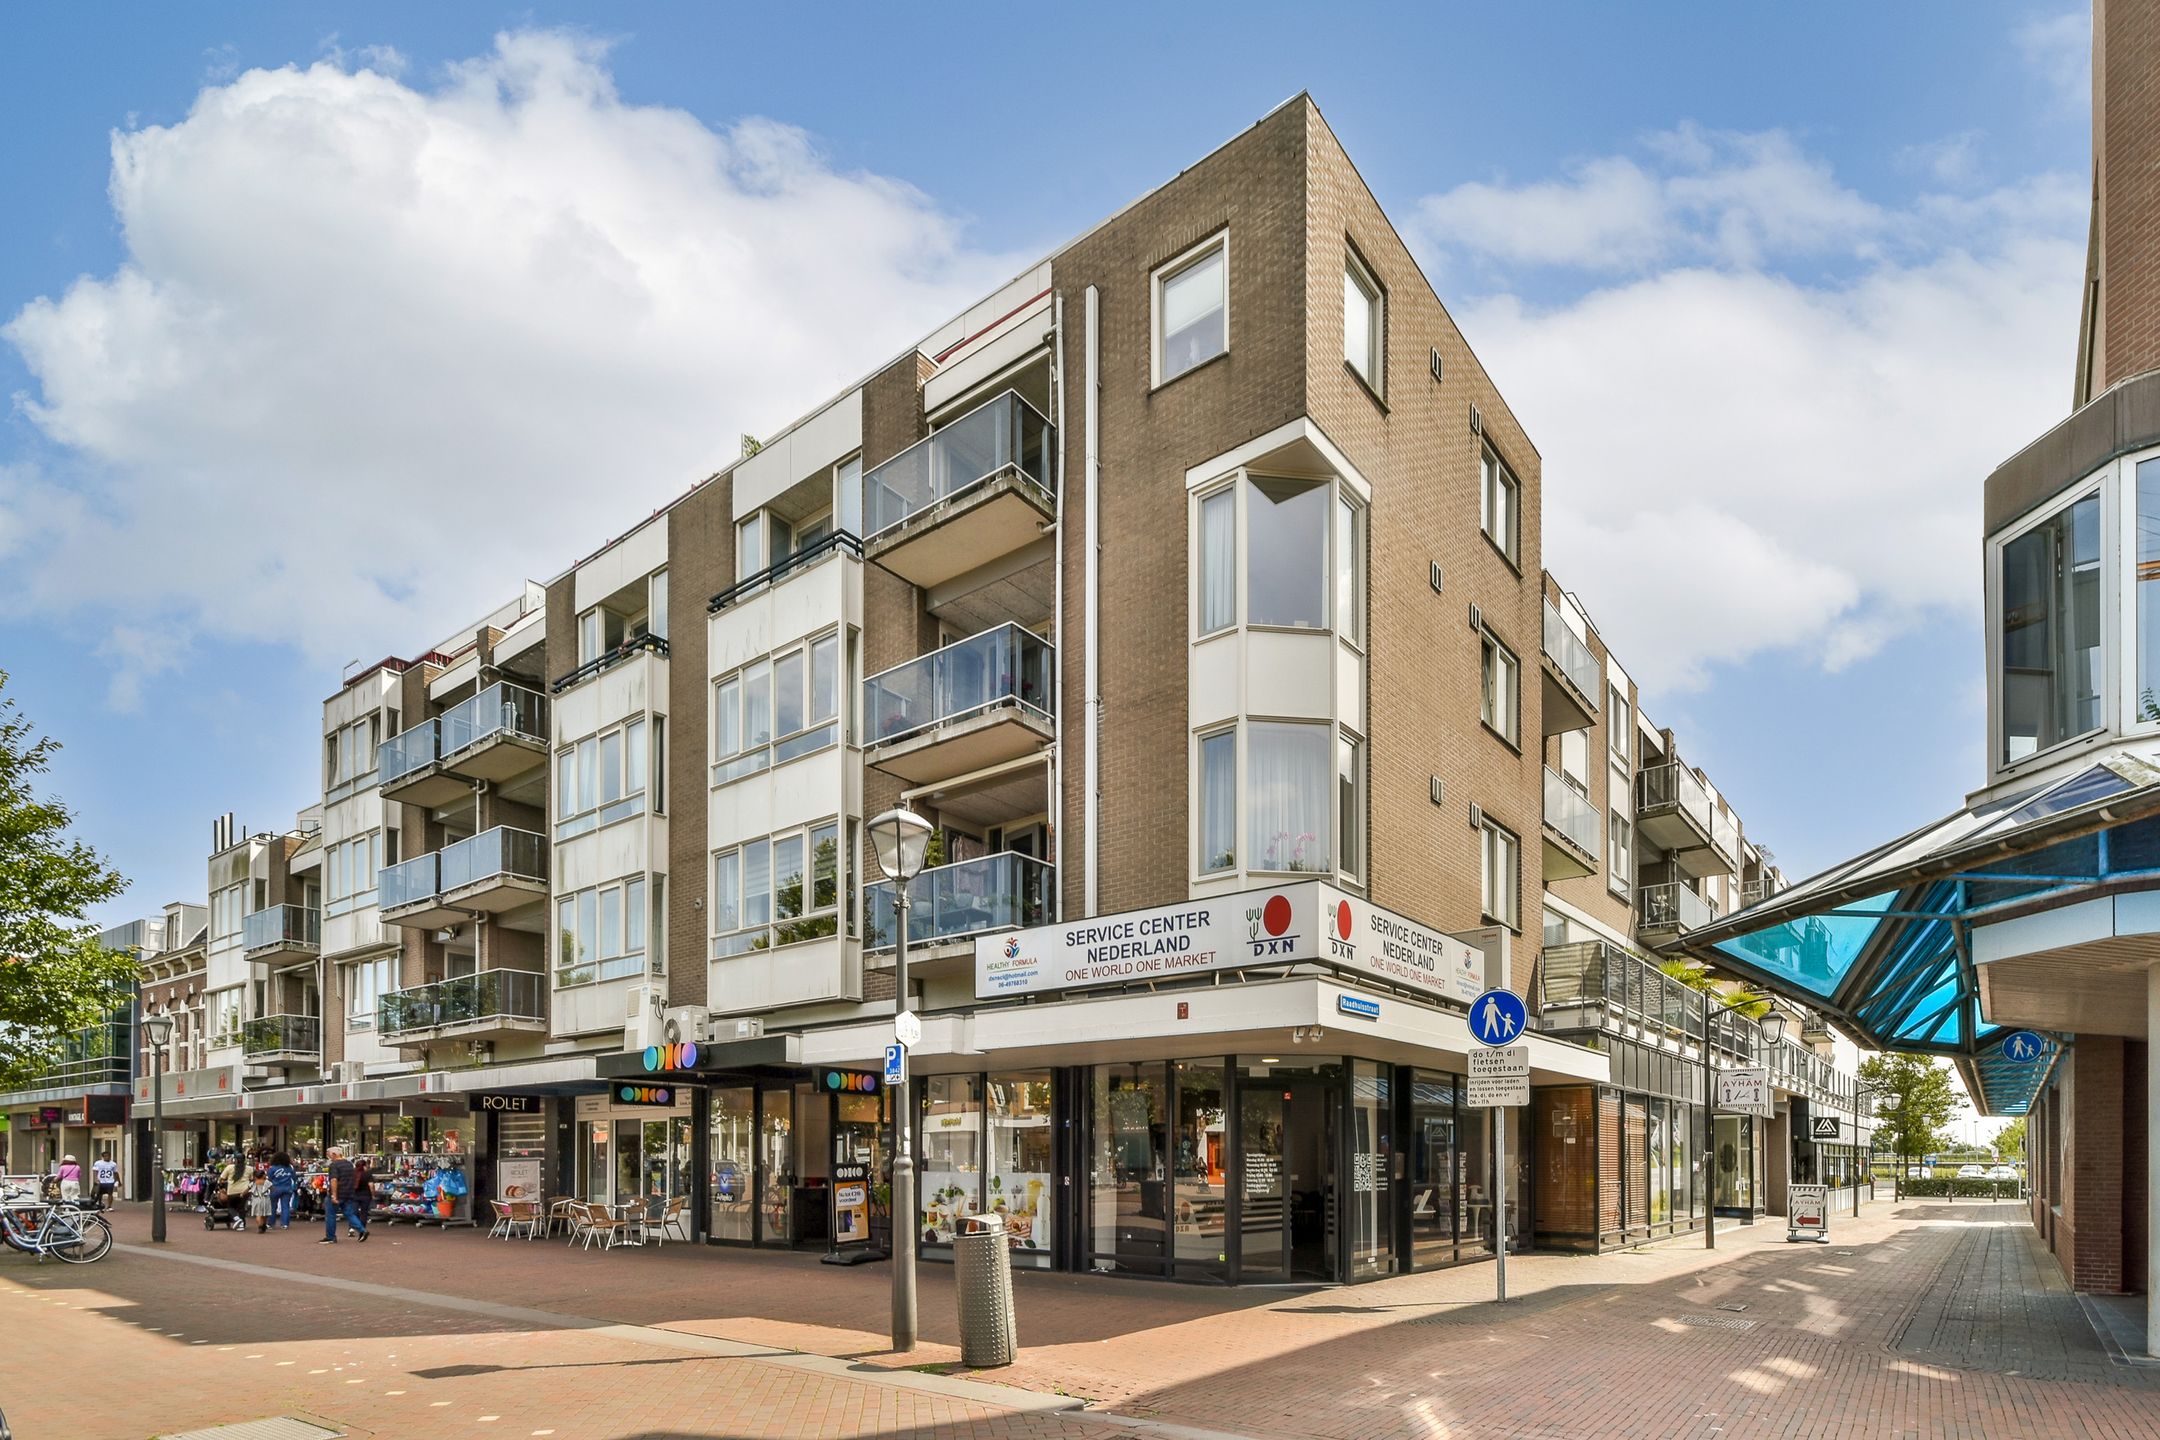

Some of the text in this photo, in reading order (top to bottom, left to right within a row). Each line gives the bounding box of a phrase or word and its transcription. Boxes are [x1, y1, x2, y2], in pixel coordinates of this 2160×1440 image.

[1066, 911, 1211, 947] SERVICE CENTER
[1371, 915, 1443, 956] SERVICE CENTER
[1087, 935, 1190, 964] NEDERLAND
[1253, 939, 1294, 957] DXN
[1332, 941, 1354, 960] DXN
[1383, 940, 1435, 972] NEDERLAND
[987, 957, 1038, 971] HEALTHY FORMULA
[1065, 951, 1217, 982] ONE WORLD ONE MARKET
[1370, 955, 1384, 971] ONE
[1385, 961, 1408, 979] WORLD
[1409, 968, 1421, 984] ONE
[1422, 973, 1446, 990] MARKET
[886, 1047, 897, 1068] P
[1473, 1058, 1505, 1066] fietsen
[1486, 1050, 1504, 1058] t/m
[1473, 1065, 1524, 1074] toegestaan
[1722, 1080, 1762, 1088] AYHAM
[483, 1096, 527, 1111] ROLET
[100, 1170, 112, 1179] 23
